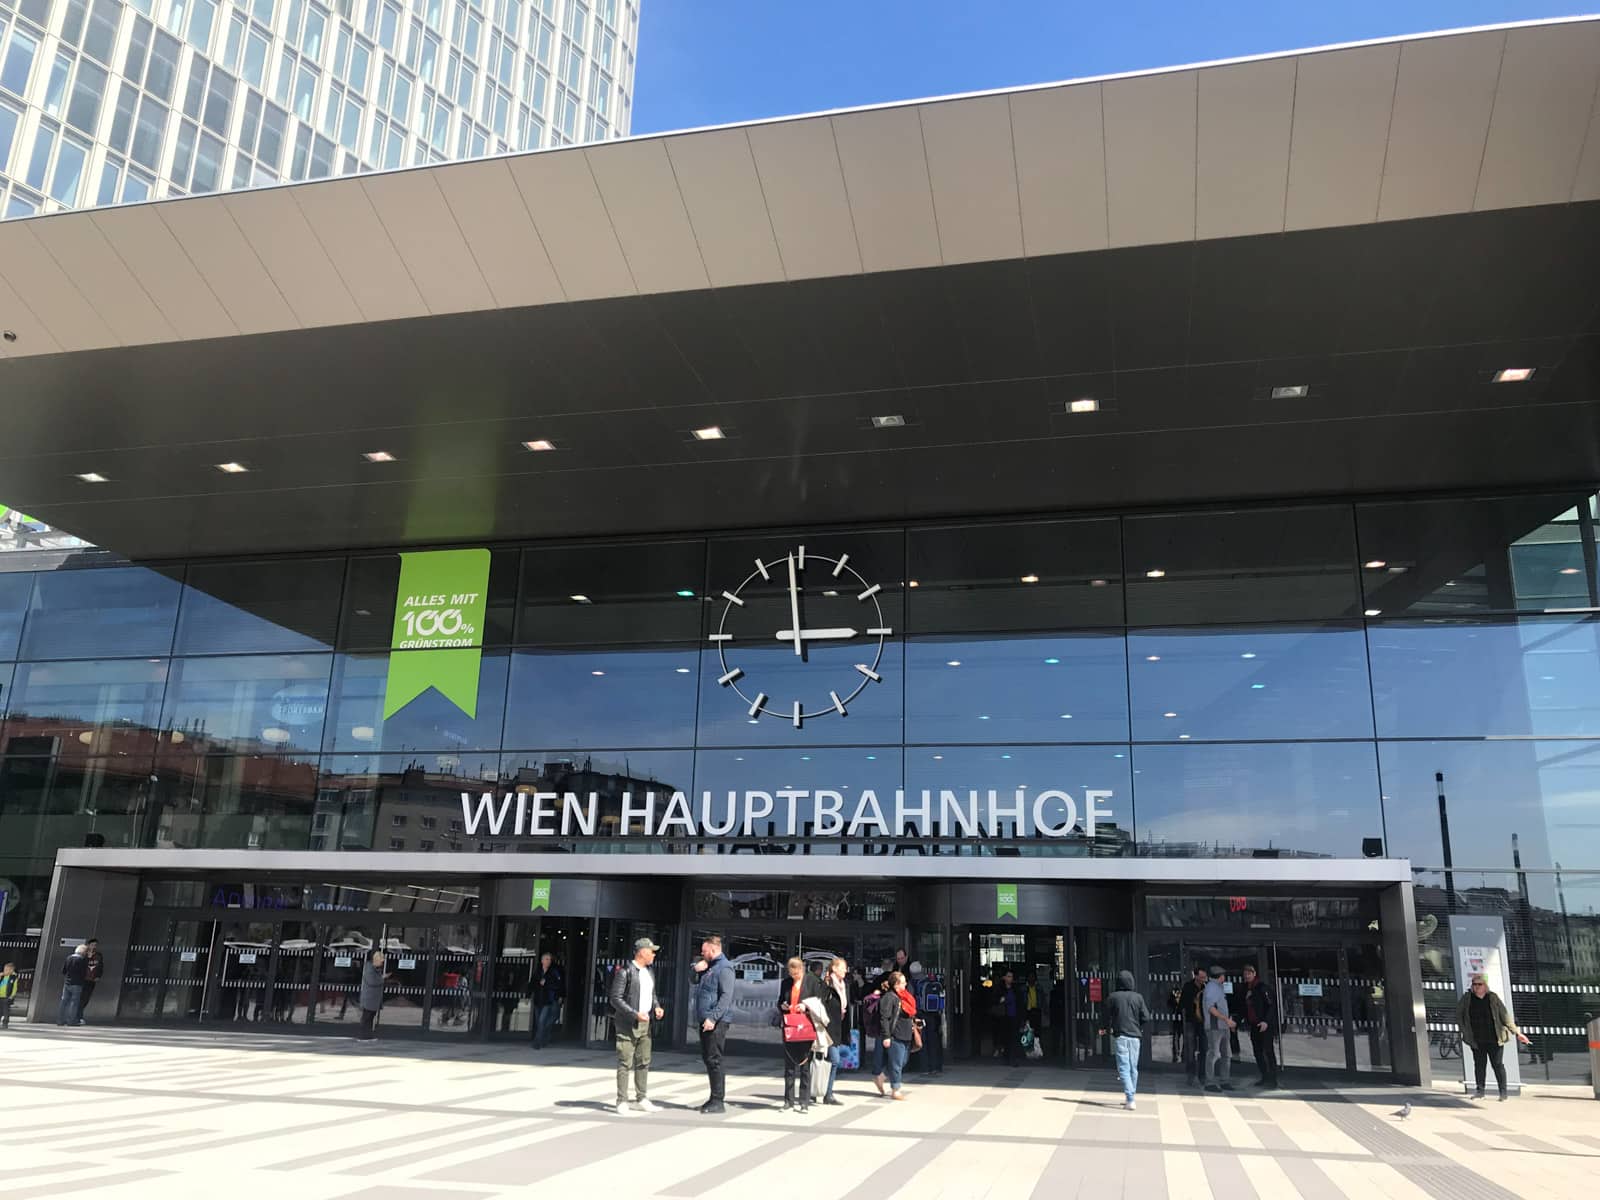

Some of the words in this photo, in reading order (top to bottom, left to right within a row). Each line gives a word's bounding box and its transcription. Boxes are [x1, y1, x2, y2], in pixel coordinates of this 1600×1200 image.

[404, 595, 447, 607] ALLES
[450, 593, 479, 605] MIT
[402, 608, 475, 636] 100%
[400, 638, 473, 649] GRÜNSTROM
[460, 791, 598, 836] WIEN
[620, 789, 1113, 837] HAUPTBAHNHOF
